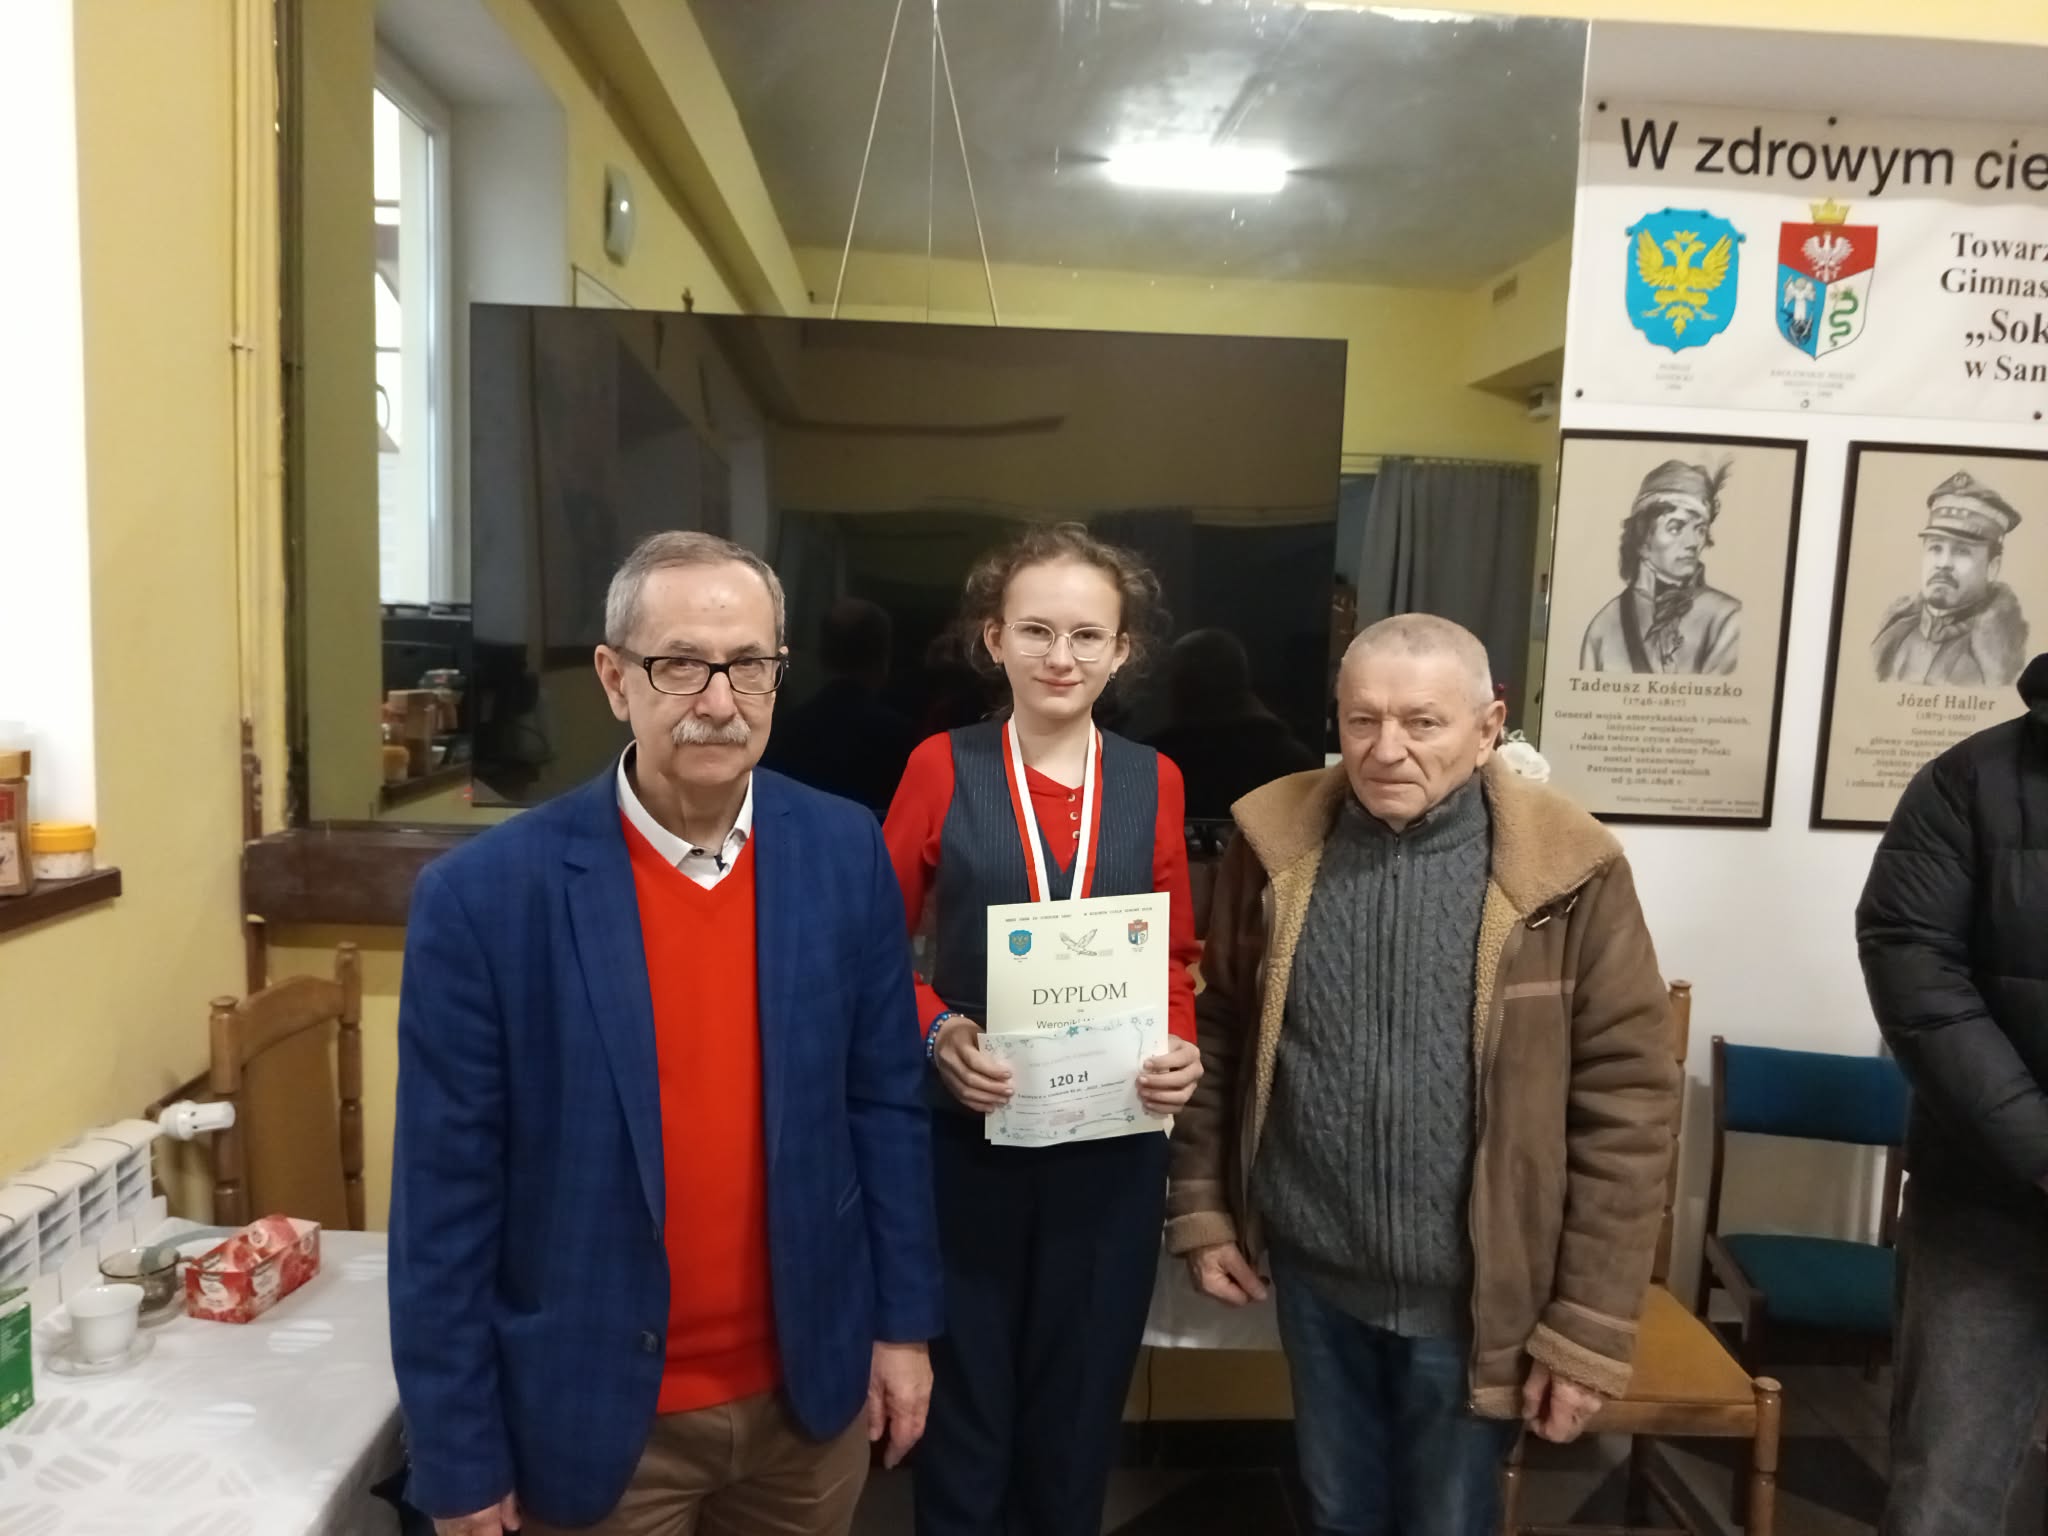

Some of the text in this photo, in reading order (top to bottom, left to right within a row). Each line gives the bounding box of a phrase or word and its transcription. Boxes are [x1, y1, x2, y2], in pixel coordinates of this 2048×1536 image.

[1620, 117, 2048, 197] W zdrowym cie
[1965, 354, 2047, 382] w San
[1569, 677, 1743, 697] Tadeusz Kościuszko
[1896, 692, 1997, 711] Józef Haller
[1032, 982, 1128, 1006] DYPLOM
[1049, 1070, 1089, 1089] 120 zł
